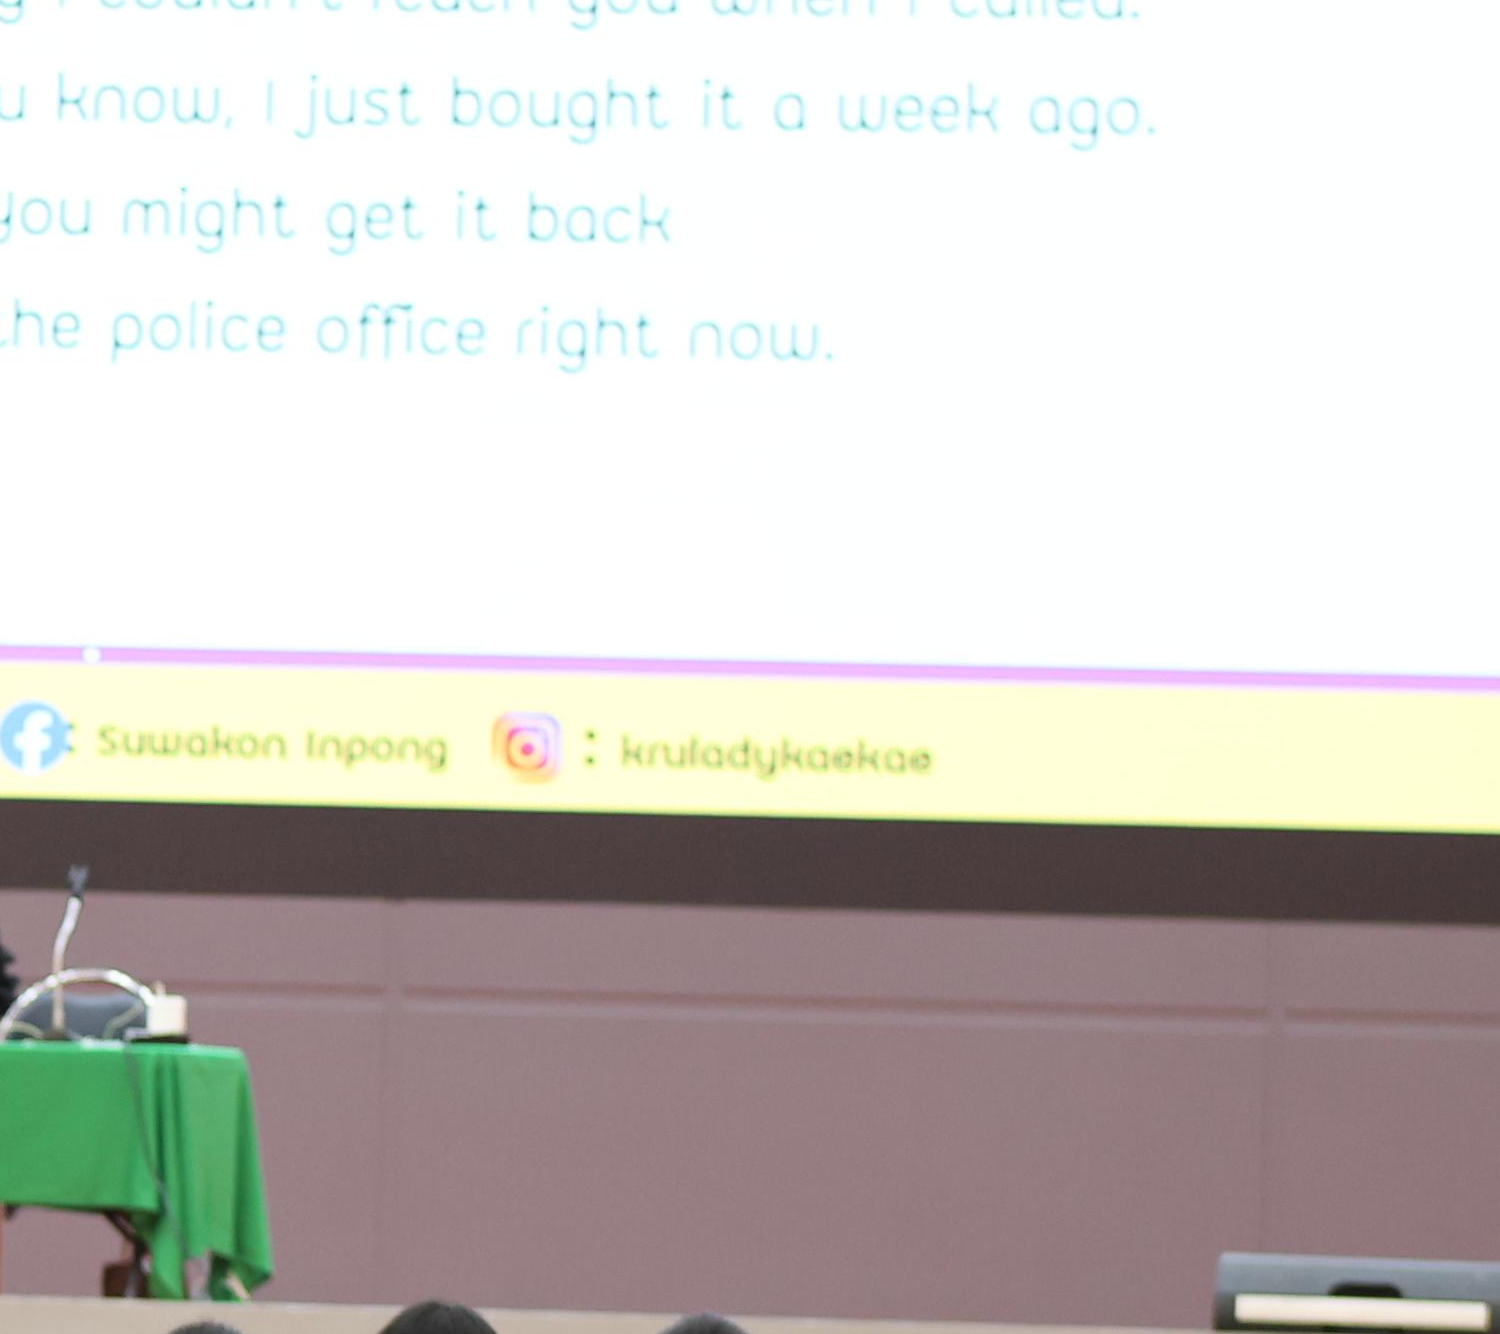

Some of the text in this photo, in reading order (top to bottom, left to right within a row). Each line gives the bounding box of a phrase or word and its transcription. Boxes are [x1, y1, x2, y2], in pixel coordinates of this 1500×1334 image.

[55, 71, 234, 129] know,
[293, 73, 422, 141] just
[449, 74, 671, 146] bought
[702, 77, 743, 132] it
[773, 91, 808, 133] a
[837, 82, 1000, 135] week
[1028, 94, 1157, 153] ago.
[121, 185, 297, 256] might
[325, 195, 425, 258] get
[456, 188, 498, 243] it
[526, 190, 671, 245] back
[110, 298, 288, 364] police
[315, 300, 488, 360] office
[515, 303, 659, 375] right
[688, 319, 835, 362] now.
[96, 724, 288, 759] Suwakon
[305, 729, 450, 772] Inpong
[620, 732, 935, 779] kruladykaekae
